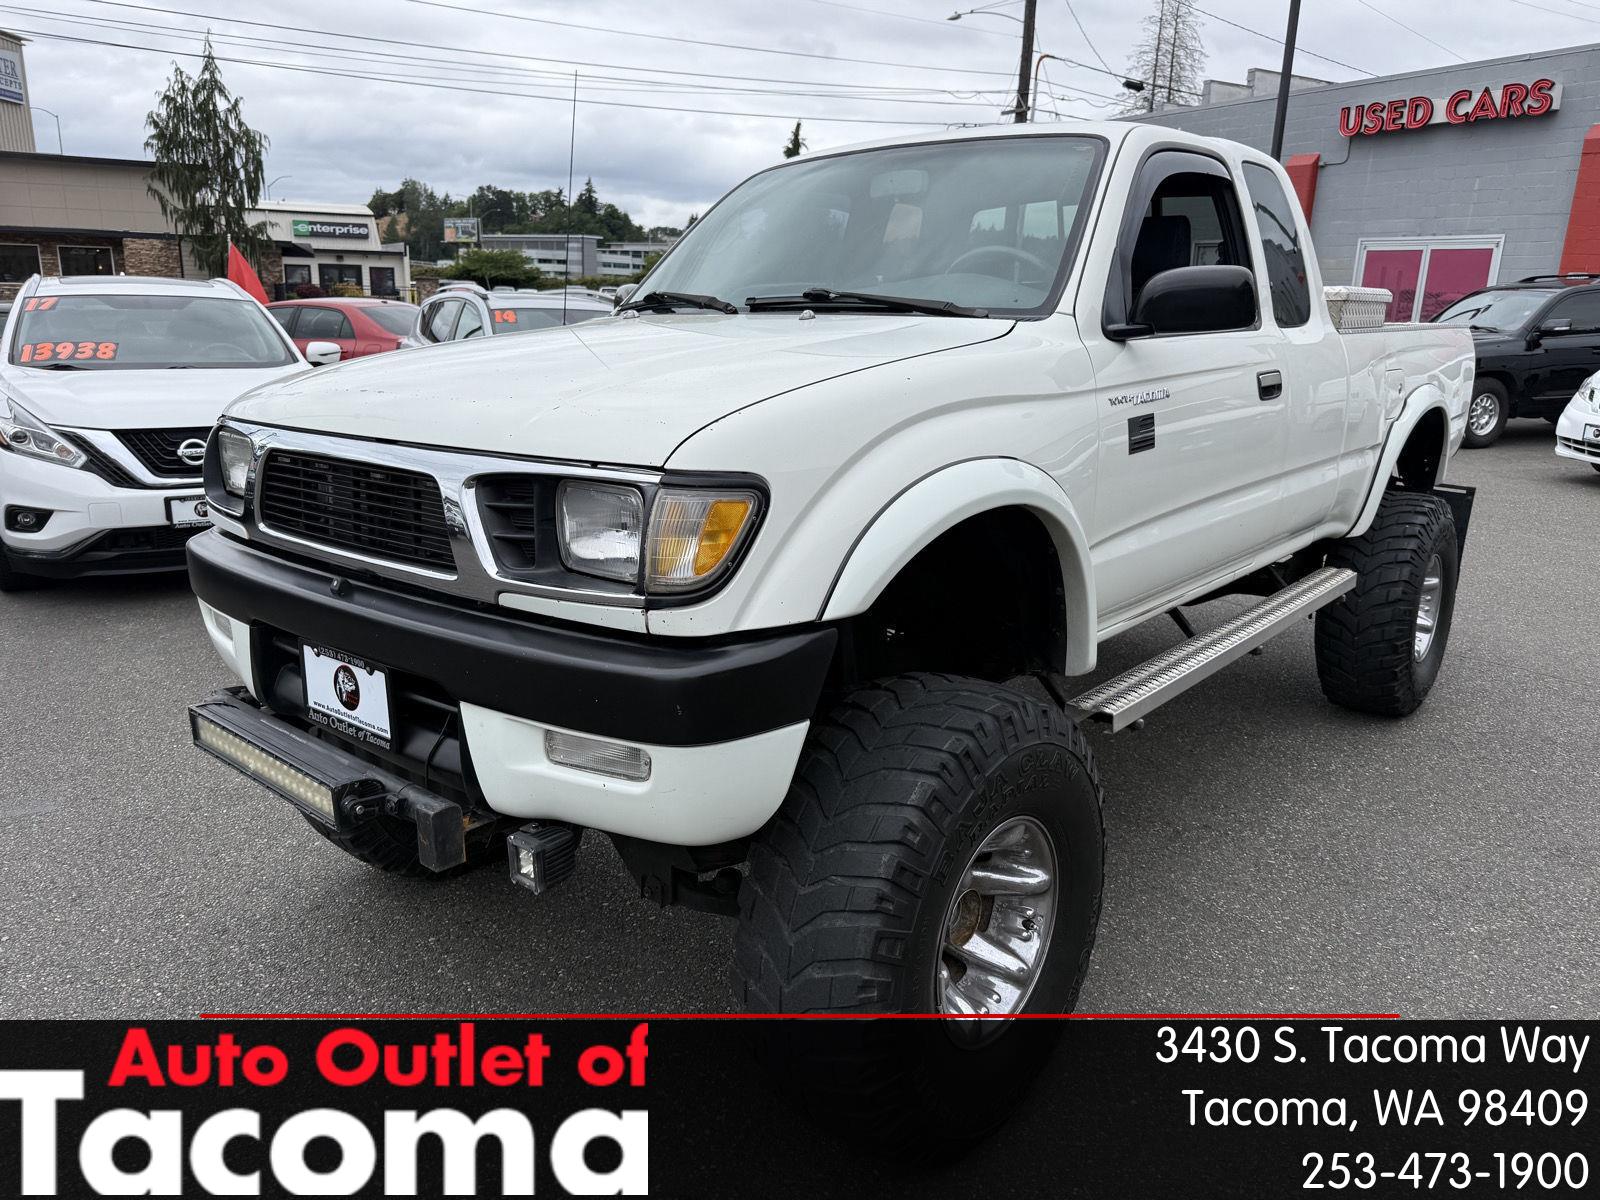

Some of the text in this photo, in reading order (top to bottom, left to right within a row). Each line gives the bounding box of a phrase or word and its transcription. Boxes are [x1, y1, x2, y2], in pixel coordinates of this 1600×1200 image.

[1338, 78, 1555, 137] USED CARS
[294, 223, 368, 235] enterprise
[25, 296, 59, 312] 17
[495, 310, 517, 323] 14
[20, 341, 117, 363] 13938
[308, 708, 328, 725] Auto
[329, 716, 357, 737] Outlet
[366, 730, 391, 750] Tacoma
